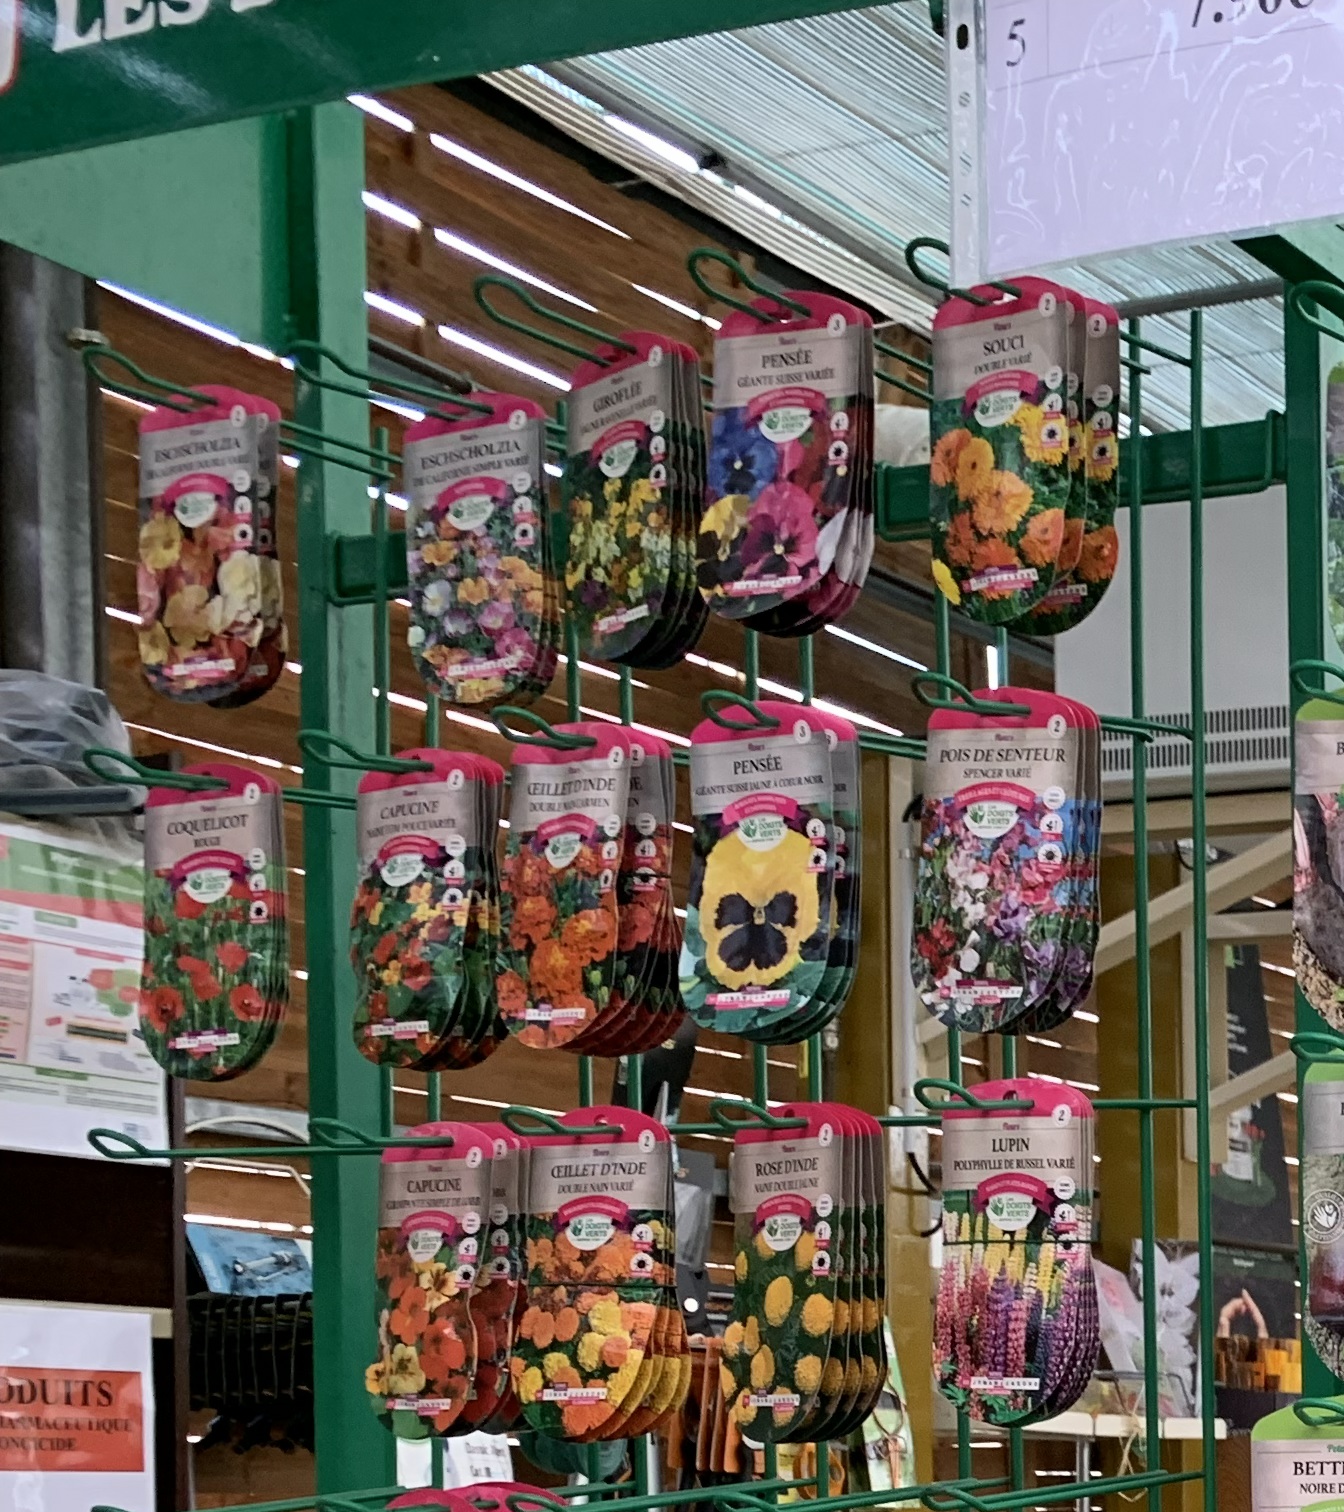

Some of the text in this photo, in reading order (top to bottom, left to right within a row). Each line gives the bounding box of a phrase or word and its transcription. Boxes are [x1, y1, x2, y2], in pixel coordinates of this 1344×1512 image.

[1007, 19, 1025, 66] 5
[983, 335, 1024, 356] SOUCI
[762, 349, 812, 368] PENSÉE
[940, 748, 1066, 763] POIS DE SENTEUR
[734, 755, 782, 775] PENSÉE
[525, 777, 616, 797] ŒILLET D'INDE
[380, 801, 438, 819] CAPUCINE
[167, 814, 248, 836] COQUELICOT
[992, 1138, 1029, 1152] LUPIN
[551, 1162, 647, 1178] ŒILLET D'INDE
[756, 1158, 818, 1176] ROSE D'INDE
[407, 1178, 461, 1193] CAPUCINE
